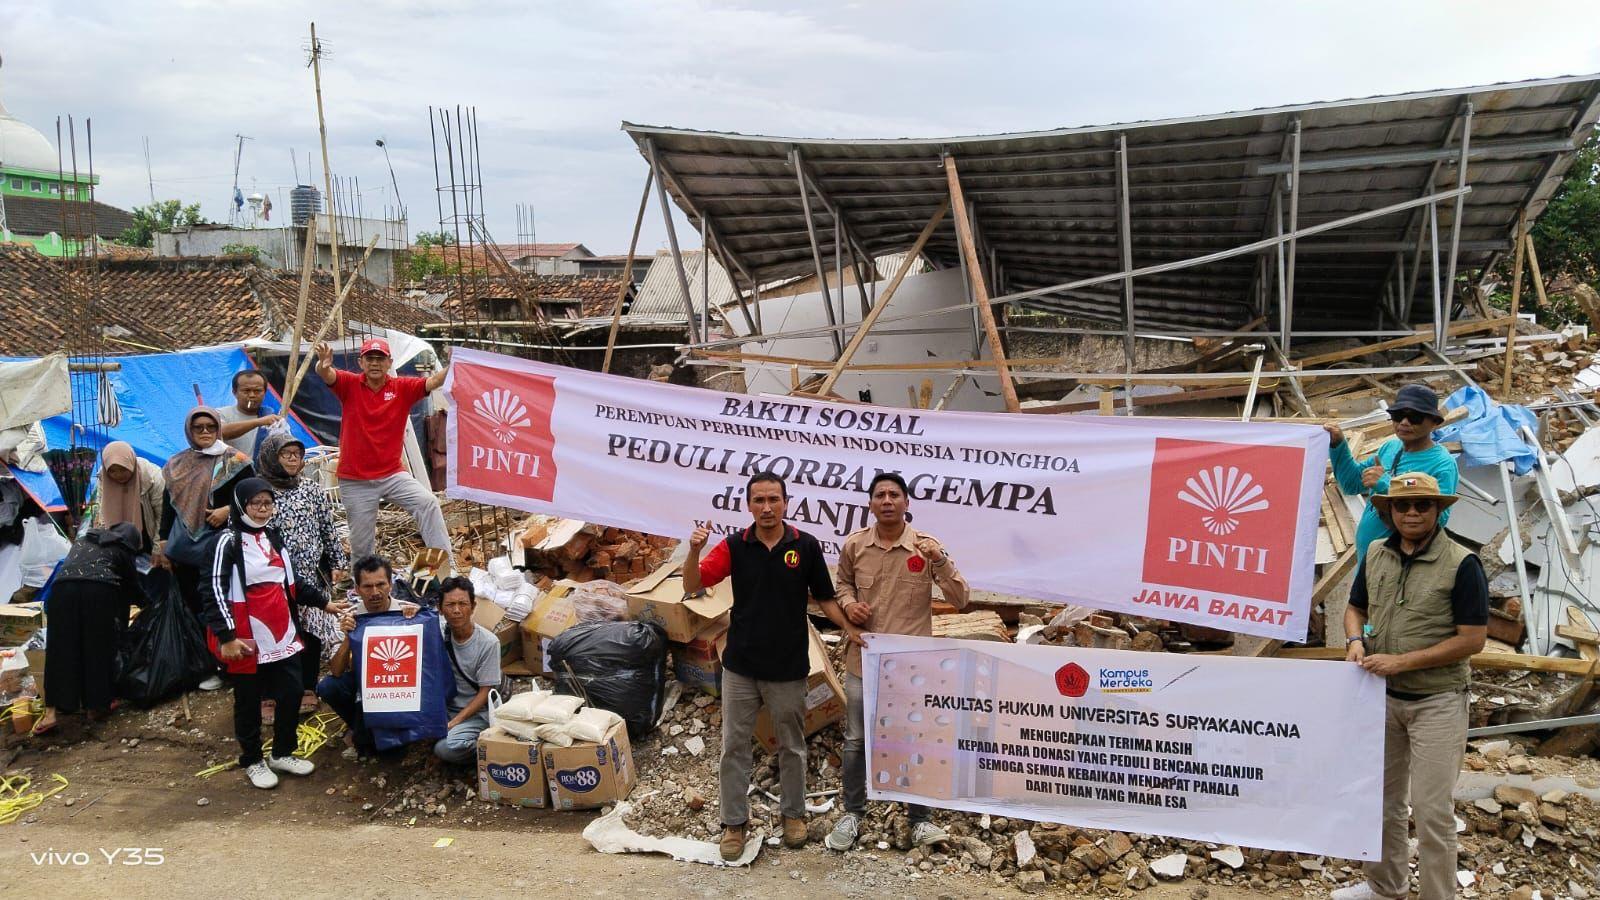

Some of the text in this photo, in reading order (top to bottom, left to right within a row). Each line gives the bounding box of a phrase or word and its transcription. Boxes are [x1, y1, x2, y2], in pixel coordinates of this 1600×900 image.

[720, 397, 925, 437] BAKTI SOSIAL
[594, 403, 1081, 474] PEREMPUAN PERHIMPUNAN INDONESIA TIONGHOA
[470, 445, 541, 478] PINTI
[607, 433, 737, 475] PEDULI
[907, 472, 1057, 516] GEMPA
[711, 486, 746, 512] di
[1166, 536, 1270, 575] PINTI
[1132, 588, 1293, 627] JAWA BARAT
[374, 674, 409, 684] PINTI
[1100, 668, 1149, 680] Kampus
[1100, 678, 1153, 688] Merdeka
[366, 691, 416, 700] JAWA BARAT
[924, 694, 1301, 739] FAKULTAS HUKUM UNIVERSITAS SURYAKANCANA
[957, 738, 1264, 780] KEPADA PARA DONASI YANG PEDULI BENCANA CIANJUR
[1020, 728, 1193, 756] MENGUCAPKAN TERIMA KASIH
[978, 757, 1239, 797] SEMOGA SEMUA KEBAIKAN MENDAPAT PAHALA
[1025, 779, 1187, 809] DARI TUHAN YANG MAHA ESA
